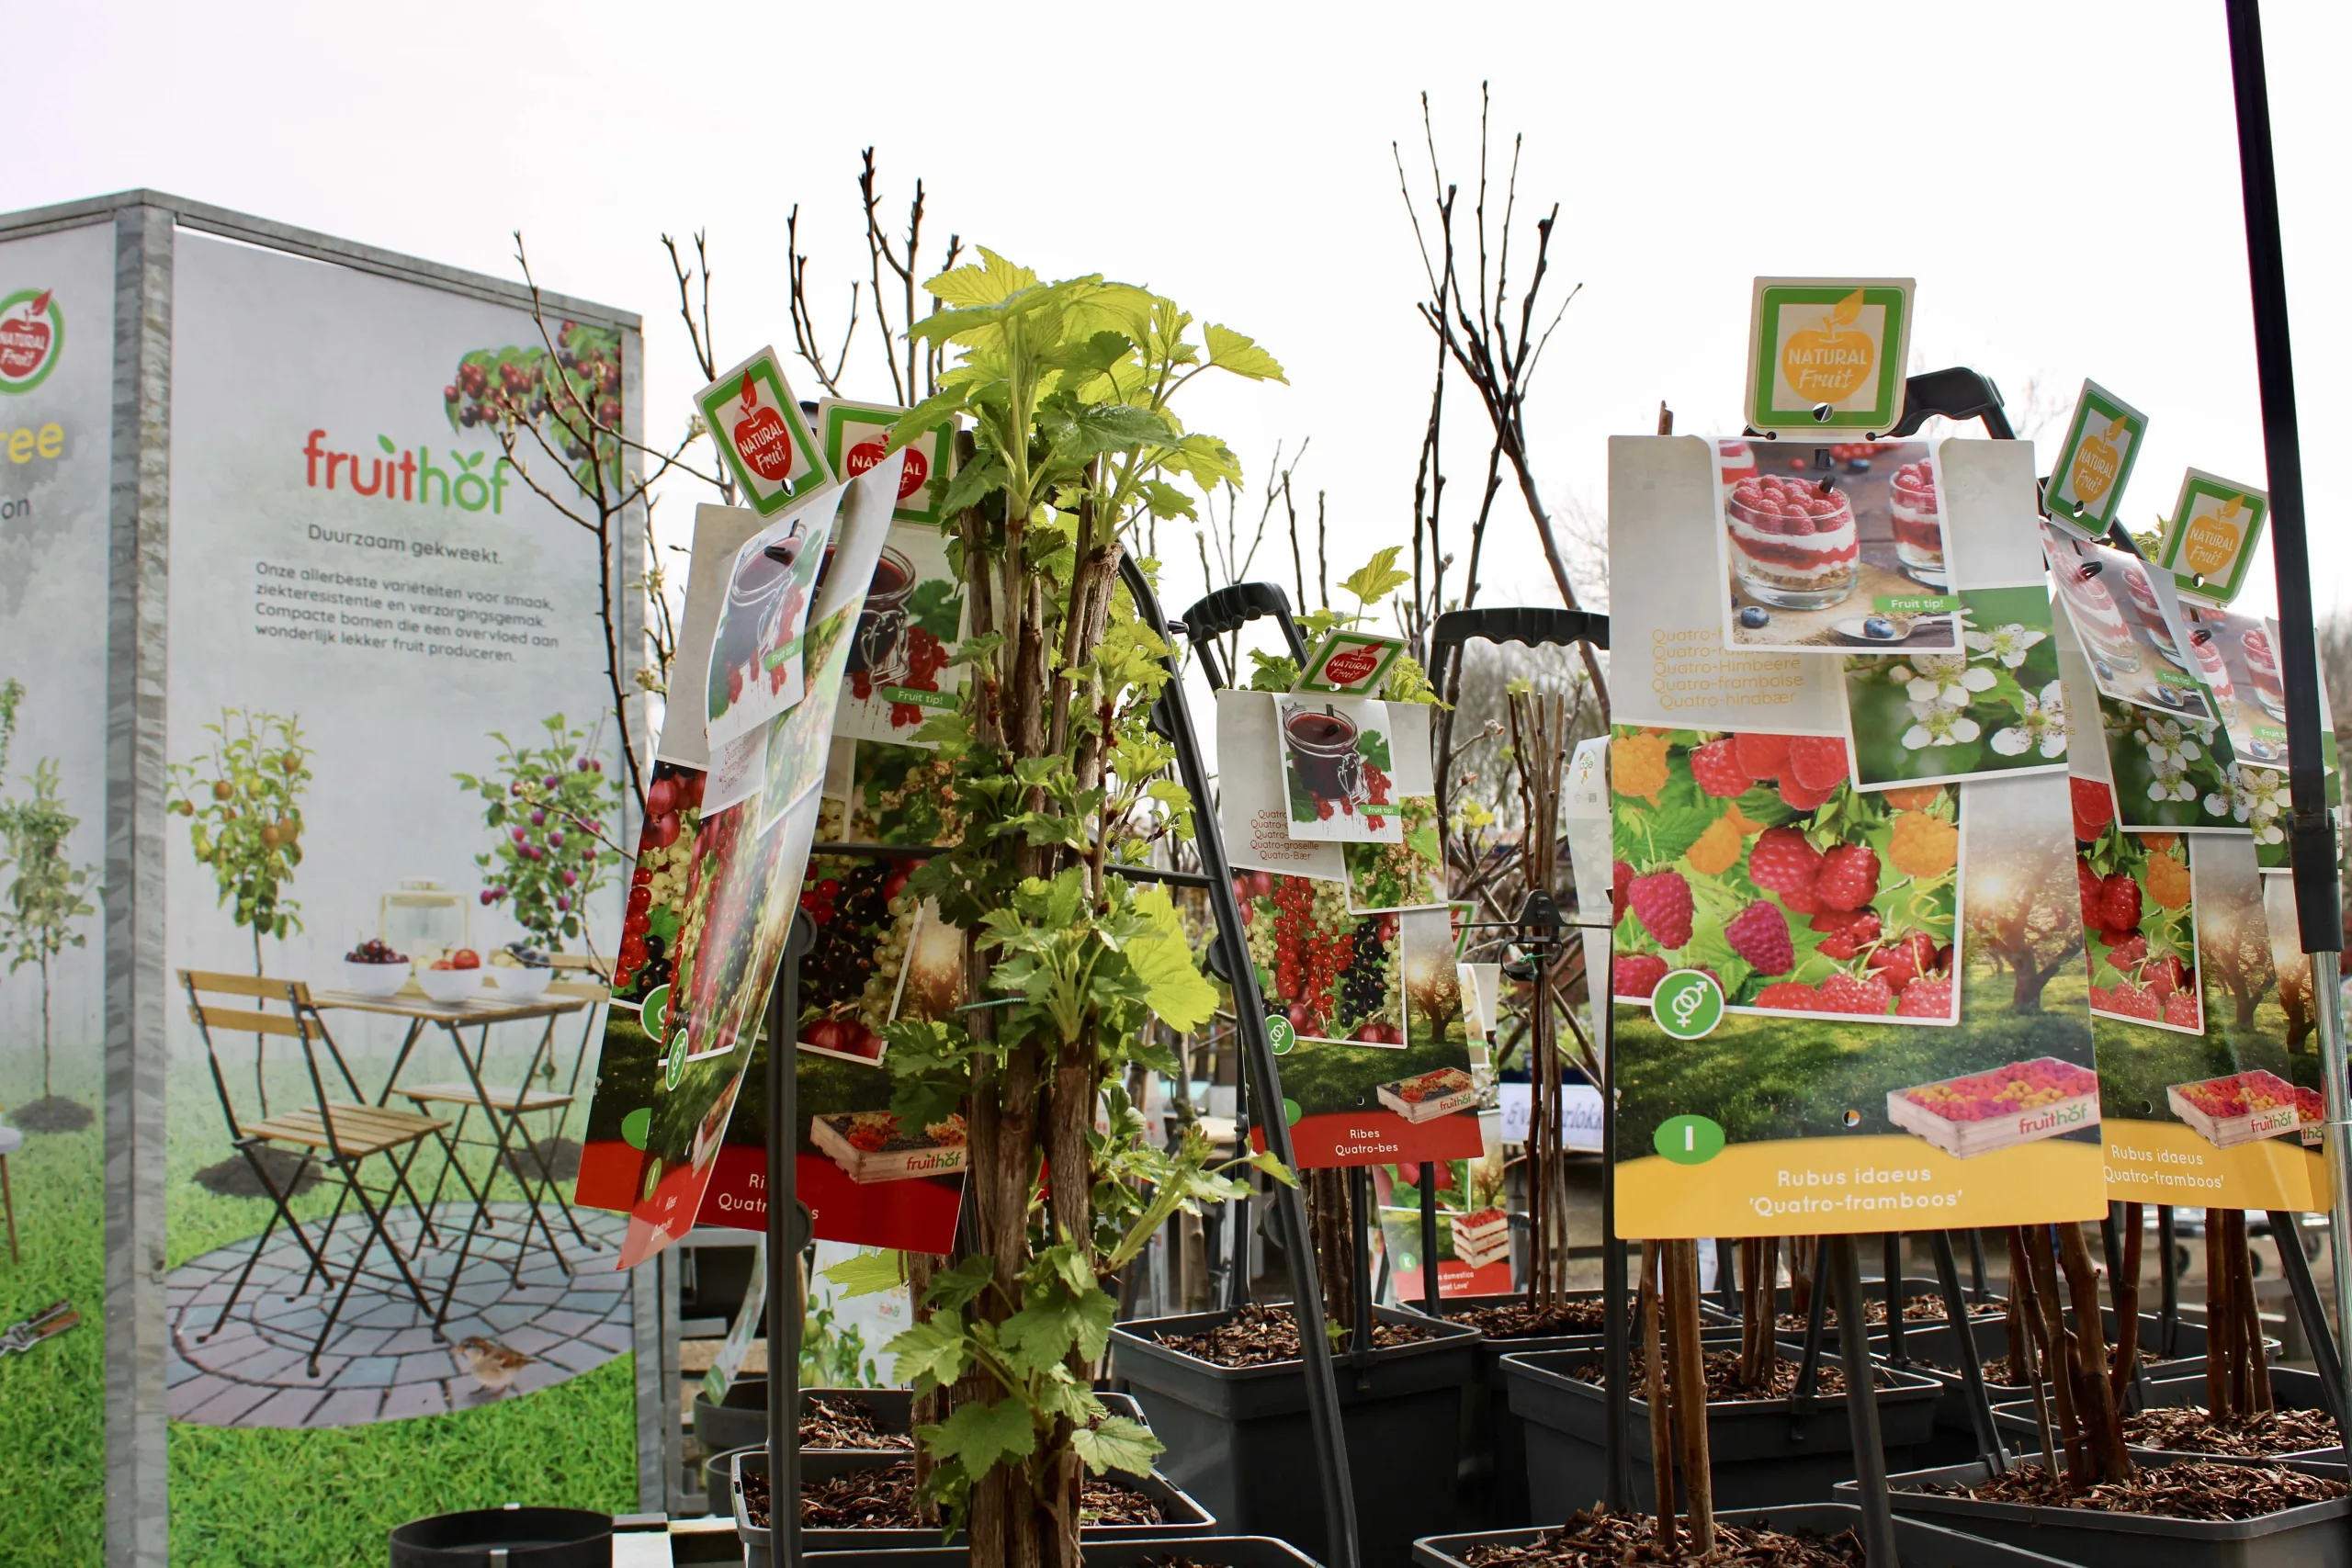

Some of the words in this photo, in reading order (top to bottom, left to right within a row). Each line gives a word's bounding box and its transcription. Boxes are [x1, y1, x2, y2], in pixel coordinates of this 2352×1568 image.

[1788, 348, 1868, 365] NATURAL
[1798, 368, 1854, 389] Fruit
[739, 420, 785, 457] NATURAL
[755, 443, 787, 474] Fruit
[852, 454, 922, 476] NATAL
[2078, 447, 2114, 479] NATURAL
[2075, 467, 2103, 494] Fruit
[308, 524, 406, 552] Duurzaam
[411, 541, 504, 565] gekweekt.
[2189, 526, 2234, 551] NATURAL
[2189, 544, 2223, 567] Fruit
[255, 561, 296, 579] Onze
[300, 567, 378, 590] allerbeste
[467, 590, 500, 604] voor
[255, 582, 383, 609] ziekteresistentie
[387, 600, 406, 612] en
[409, 603, 547, 628] verzorgingsgemak.
[1890, 597, 1920, 609] Fruit
[1923, 597, 1945, 611] tip!
[255, 602, 336, 623] Compacte
[340, 611, 393, 629] bomen
[397, 619, 420, 633] die
[424, 624, 451, 636] een
[455, 626, 527, 645] overvloed
[531, 636, 559, 648] aan
[255, 624, 336, 645] wonderlijk
[341, 631, 389, 649] lekker
[392, 637, 424, 652] fruit
[428, 643, 516, 662] produceren.
[1329, 668, 1361, 679] Fruit
[1330, 659, 1372, 671] NATURAL
[1653, 658, 1801, 678] Quatro-Himbeere
[1651, 674, 1804, 694] Quatro-framboise
[898, 690, 923, 704] Fruit
[925, 692, 943, 705] tip!
[1659, 690, 1796, 711] Quatro-hindbær
[2261, 728, 2277, 738] Fruit
[1383, 807, 1394, 816] tip!
[1250, 840, 1319, 851] Quatro-groseille
[1260, 850, 1311, 861] Quatro-Bær
[1350, 1129, 1380, 1140] Ribes
[1335, 1143, 1399, 1156] Quatro-bes
[2111, 1144, 2154, 1162] Rubus
[2156, 1147, 2203, 1166] idaeus
[1777, 1168, 1846, 1188] Rubus
[1854, 1167, 1931, 1186] idaeus
[1748, 1190, 1963, 1218] 'Quatro-framboos'
[1443, 1271, 1475, 1280] domestica
